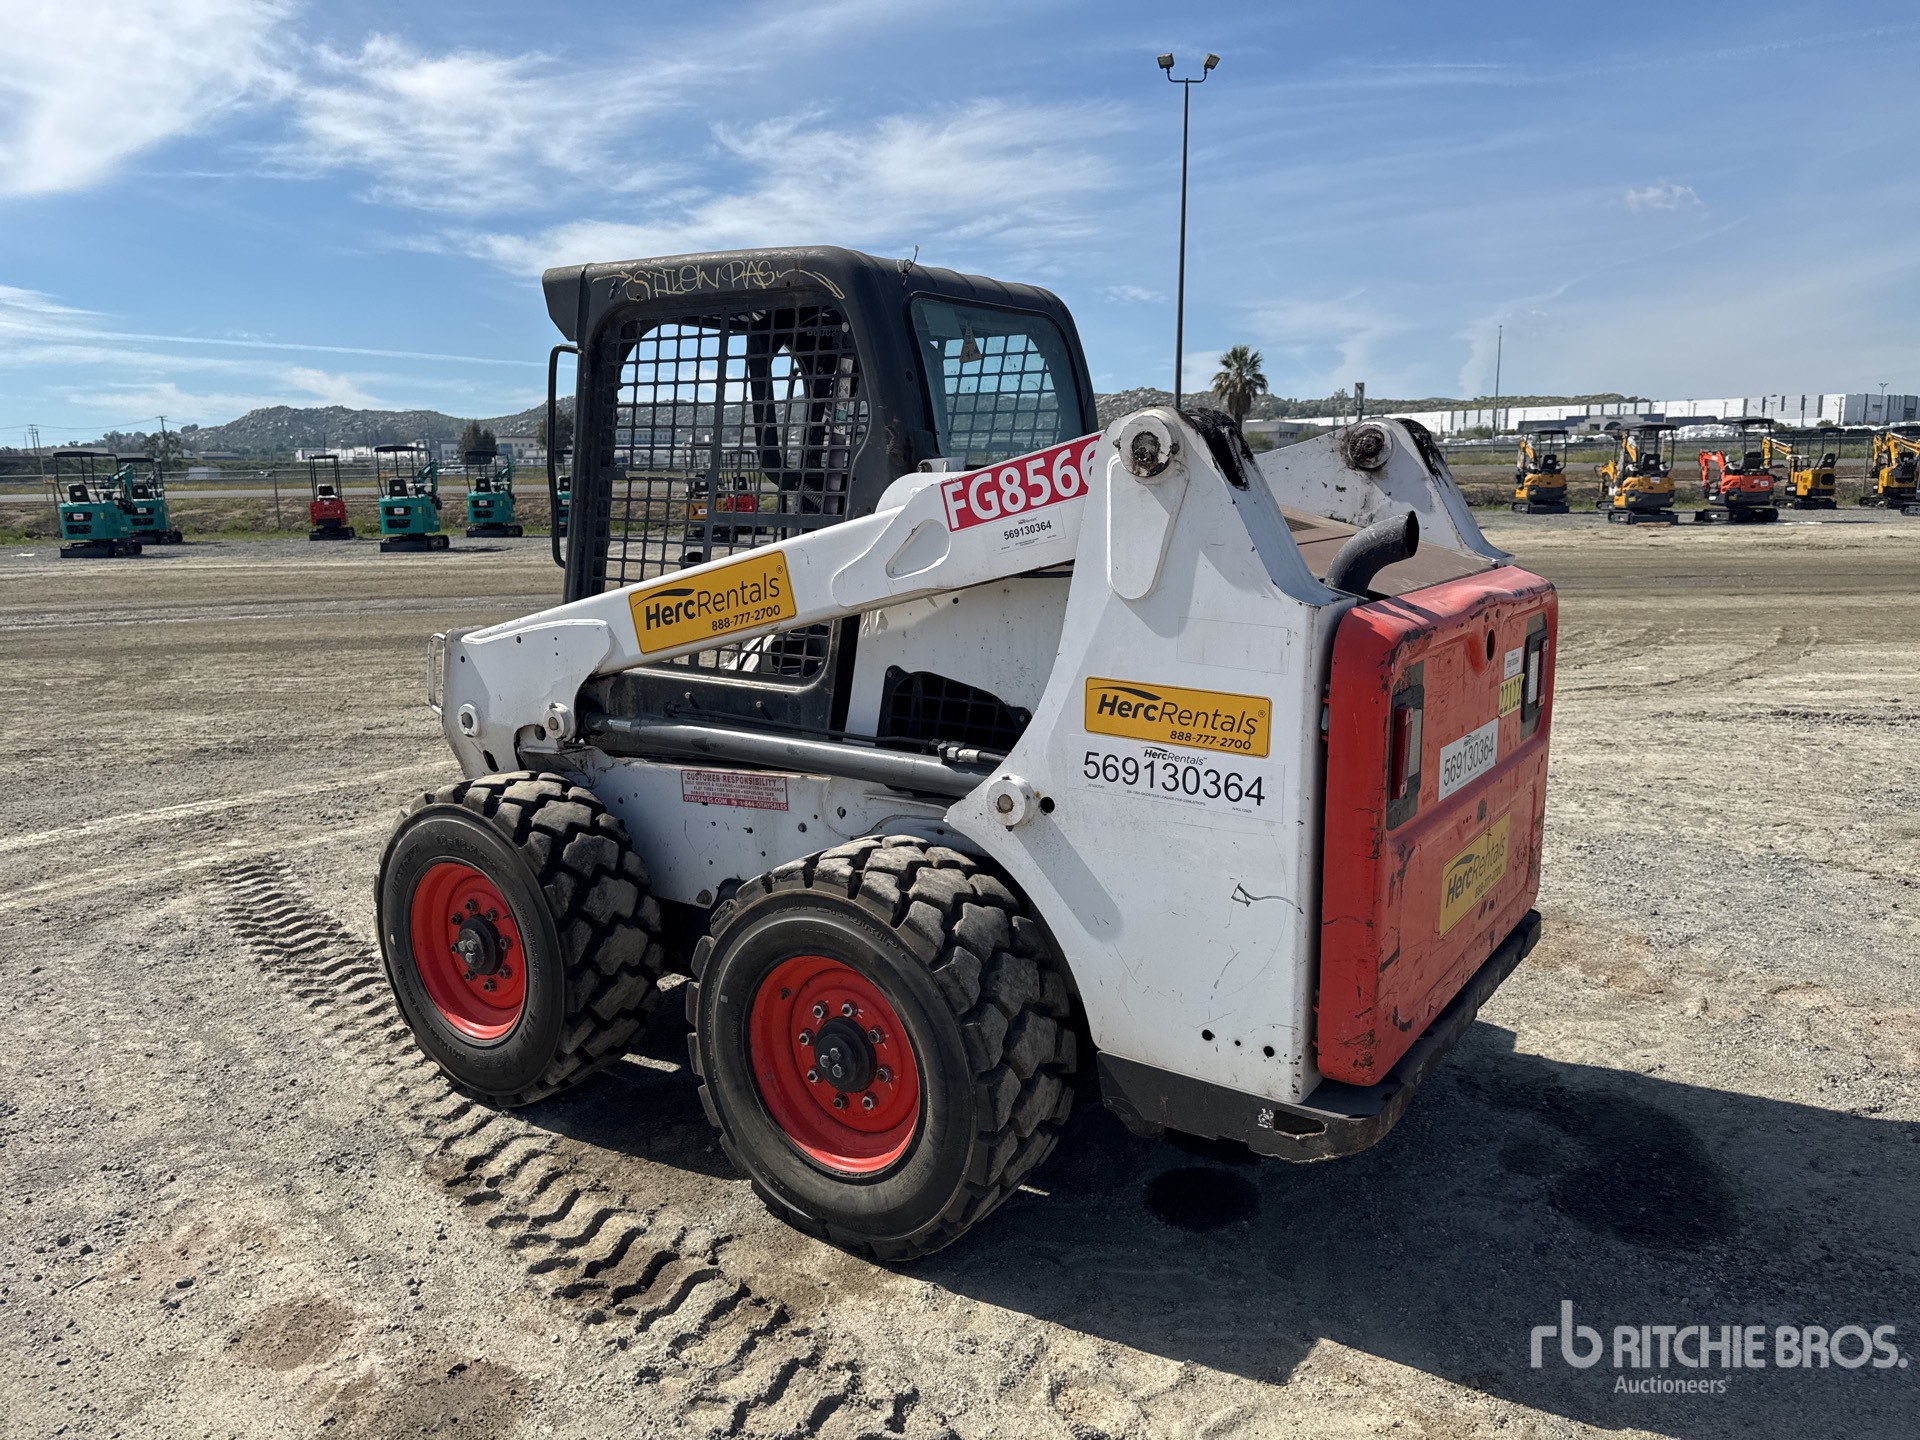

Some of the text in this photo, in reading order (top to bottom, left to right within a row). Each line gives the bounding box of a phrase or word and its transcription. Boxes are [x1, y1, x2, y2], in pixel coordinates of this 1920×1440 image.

[1003, 520, 1052, 540] 569130364
[645, 571, 780, 630] HercRentals
[711, 604, 781, 631] 888-777-2700
[1097, 693, 1258, 735] HercRentals
[1169, 730, 1252, 750] 888-777-2700
[1143, 749, 1204, 766] HercRentals
[1443, 732, 1494, 787] 569130364
[686, 772, 777, 786] CUSTOMER RESPONSIBILITY
[1083, 750, 1266, 806] 569130364
[684, 795, 728, 804] OTAYSALES.COM
[1446, 833, 1505, 908] HercRentals
